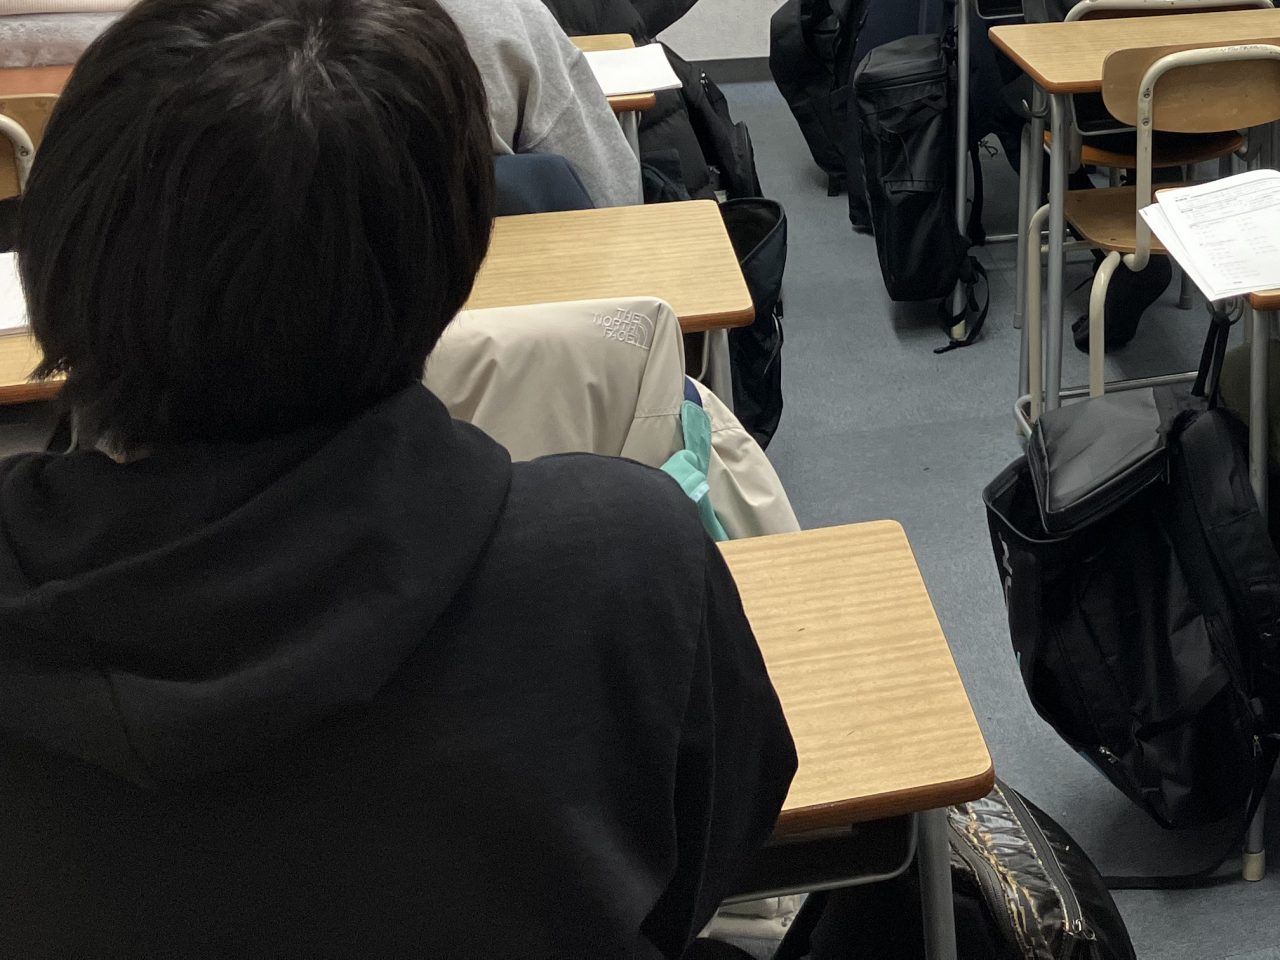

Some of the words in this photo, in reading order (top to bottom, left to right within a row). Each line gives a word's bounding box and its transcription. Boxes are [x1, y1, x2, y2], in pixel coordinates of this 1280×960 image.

[592, 312, 638, 334] NORTH
[617, 308, 641, 323] THE
[603, 328, 634, 343] FACE
